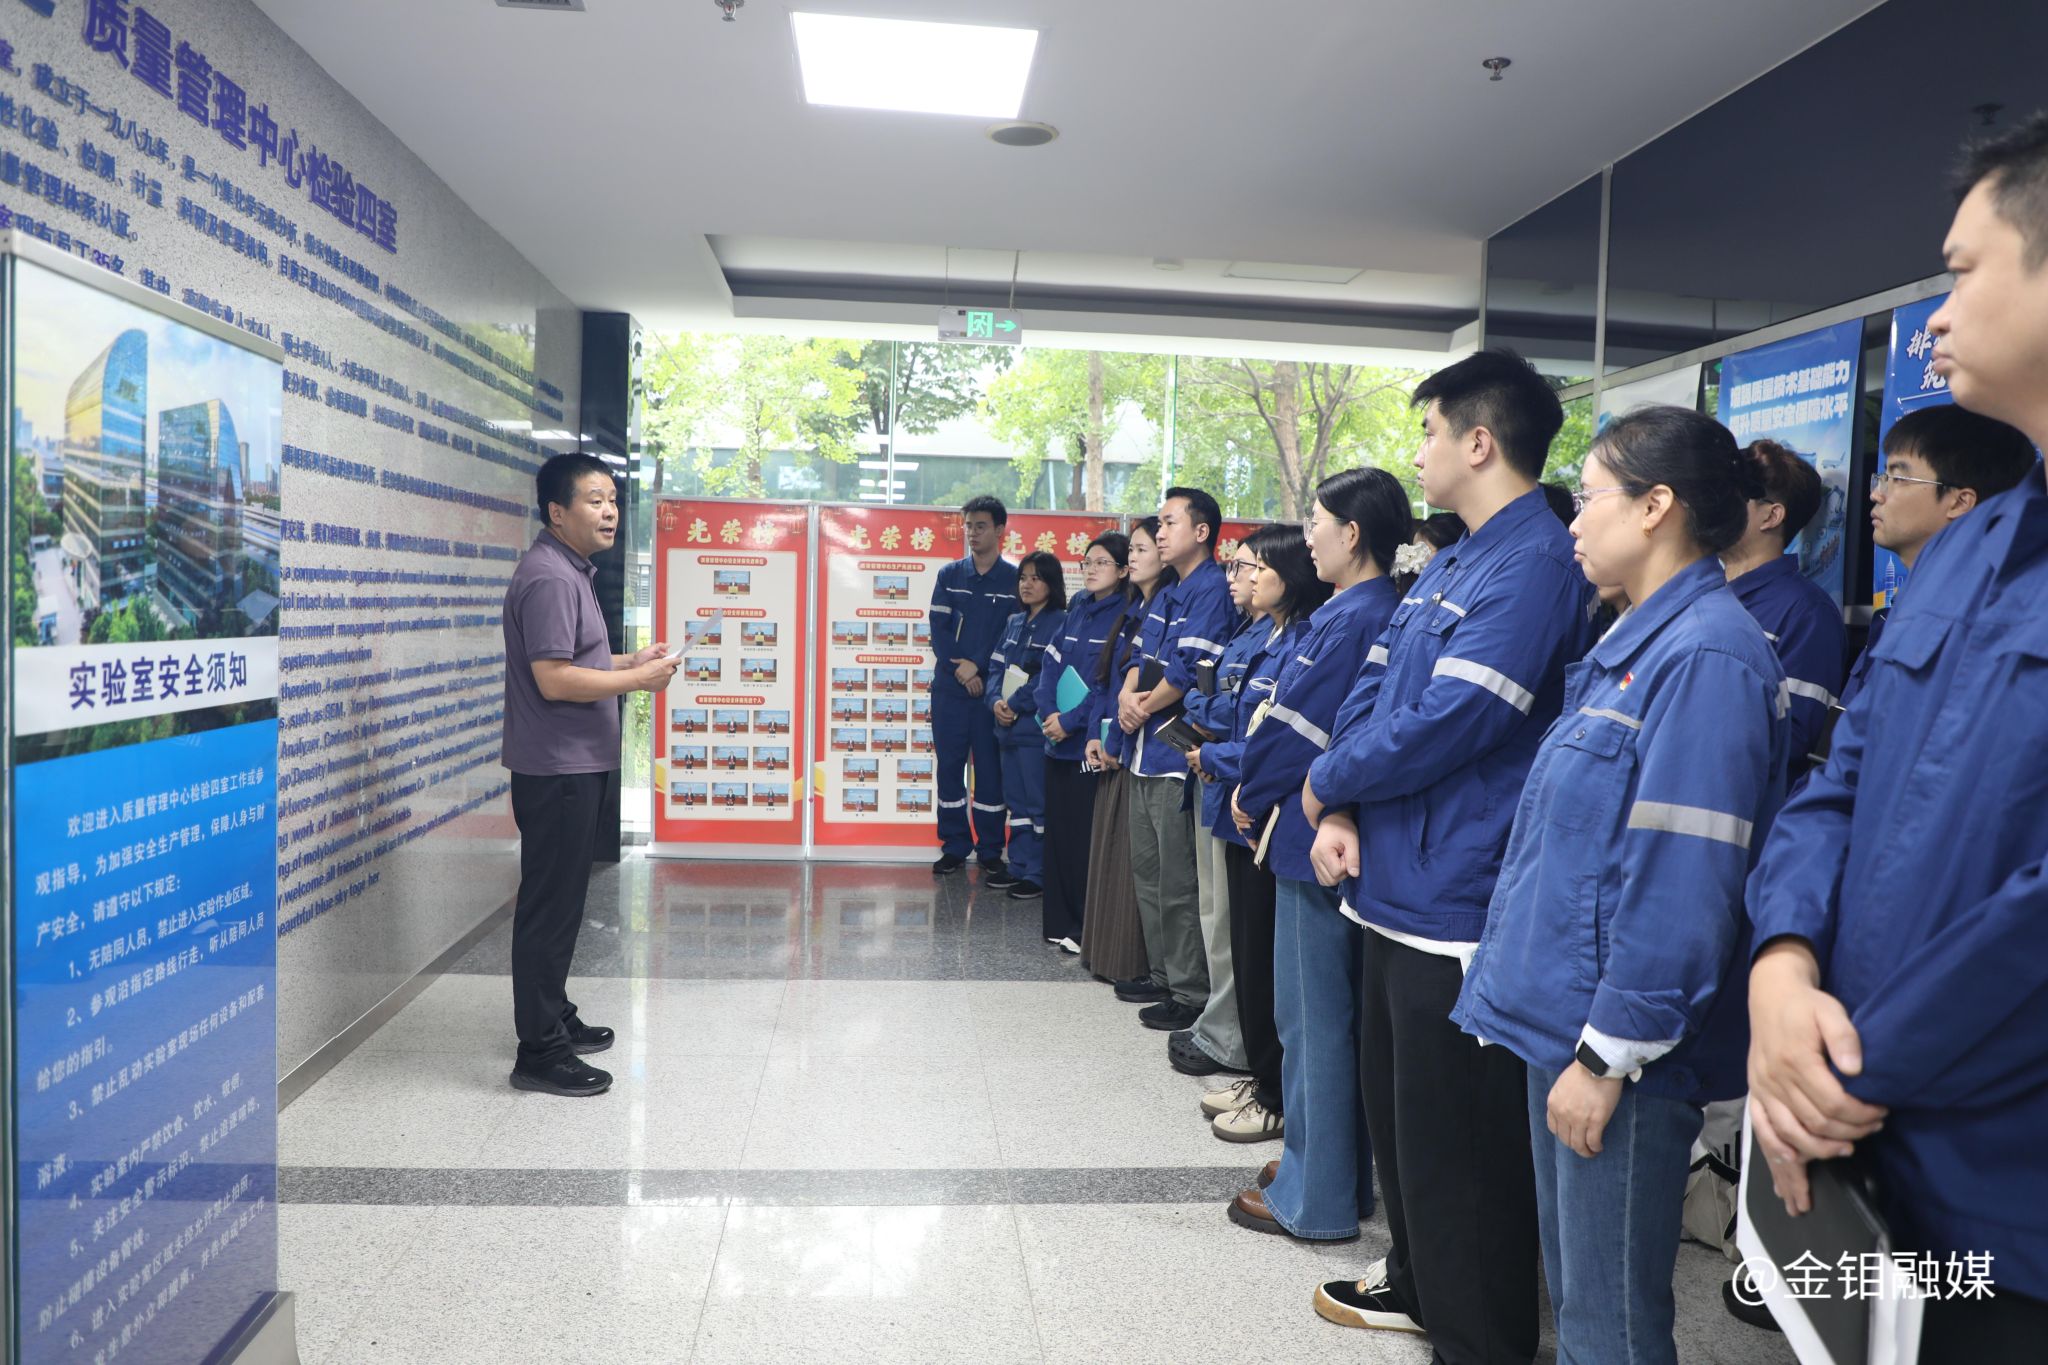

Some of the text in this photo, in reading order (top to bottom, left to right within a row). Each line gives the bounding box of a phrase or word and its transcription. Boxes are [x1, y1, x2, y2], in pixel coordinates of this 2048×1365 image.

[82, 0, 398, 255] 质量管理中心检验四室
[687, 518, 778, 546] 光荣榜
[846, 524, 936, 552] 光荣榜
[1001, 530, 1091, 556] 光荣榜
[69, 650, 248, 711] 实验室安全须知
[67, 766, 264, 838] 欢迎进入质量管理中心检验四室工作或参
[35, 803, 265, 896] 观指导，为加强安全生产管理，保障人身与财
[284, 874, 325, 906] welcome
[337, 854, 363, 878] friends
[36, 874, 181, 947] 产安全，请遵守以下规定：
[69, 882, 253, 979] 1、无陪同人员，禁止进入实验作业区域。
[314, 896, 334, 916] blue
[334, 887, 349, 906] sky
[67, 911, 264, 1028] 2、参观沿指定路线行走，听从陪同人员
[36, 1035, 113, 1093] 给您的指引。
[68, 984, 264, 1120] 3、禁止乱动实验室现场任何设备和配套
[37, 1152, 74, 1191] 溶液。
